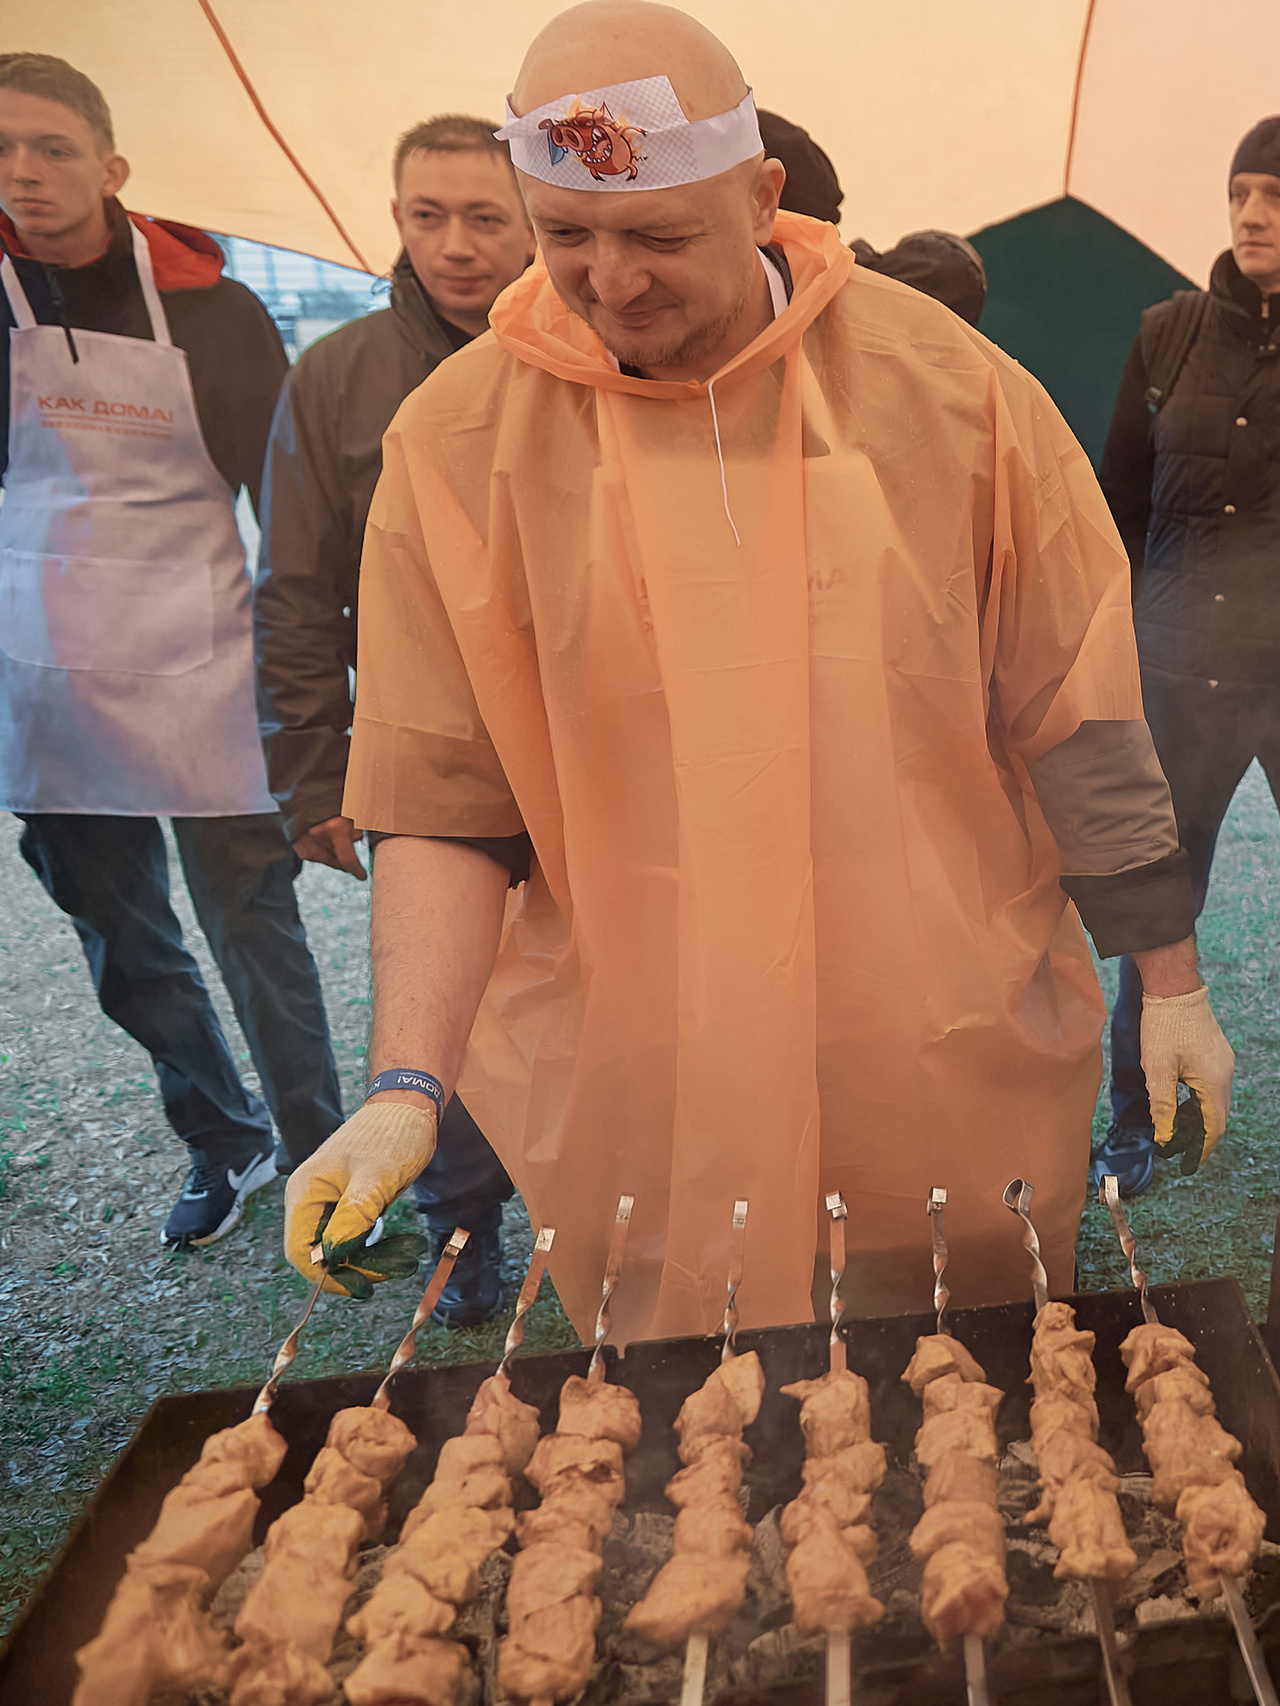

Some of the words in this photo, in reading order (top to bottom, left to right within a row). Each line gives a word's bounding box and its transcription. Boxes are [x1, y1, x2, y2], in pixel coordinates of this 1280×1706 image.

[38, 396, 85, 412] КАК
[92, 400, 174, 423] ДОМА!
[396, 1075, 440, 1099] ДОМА!
